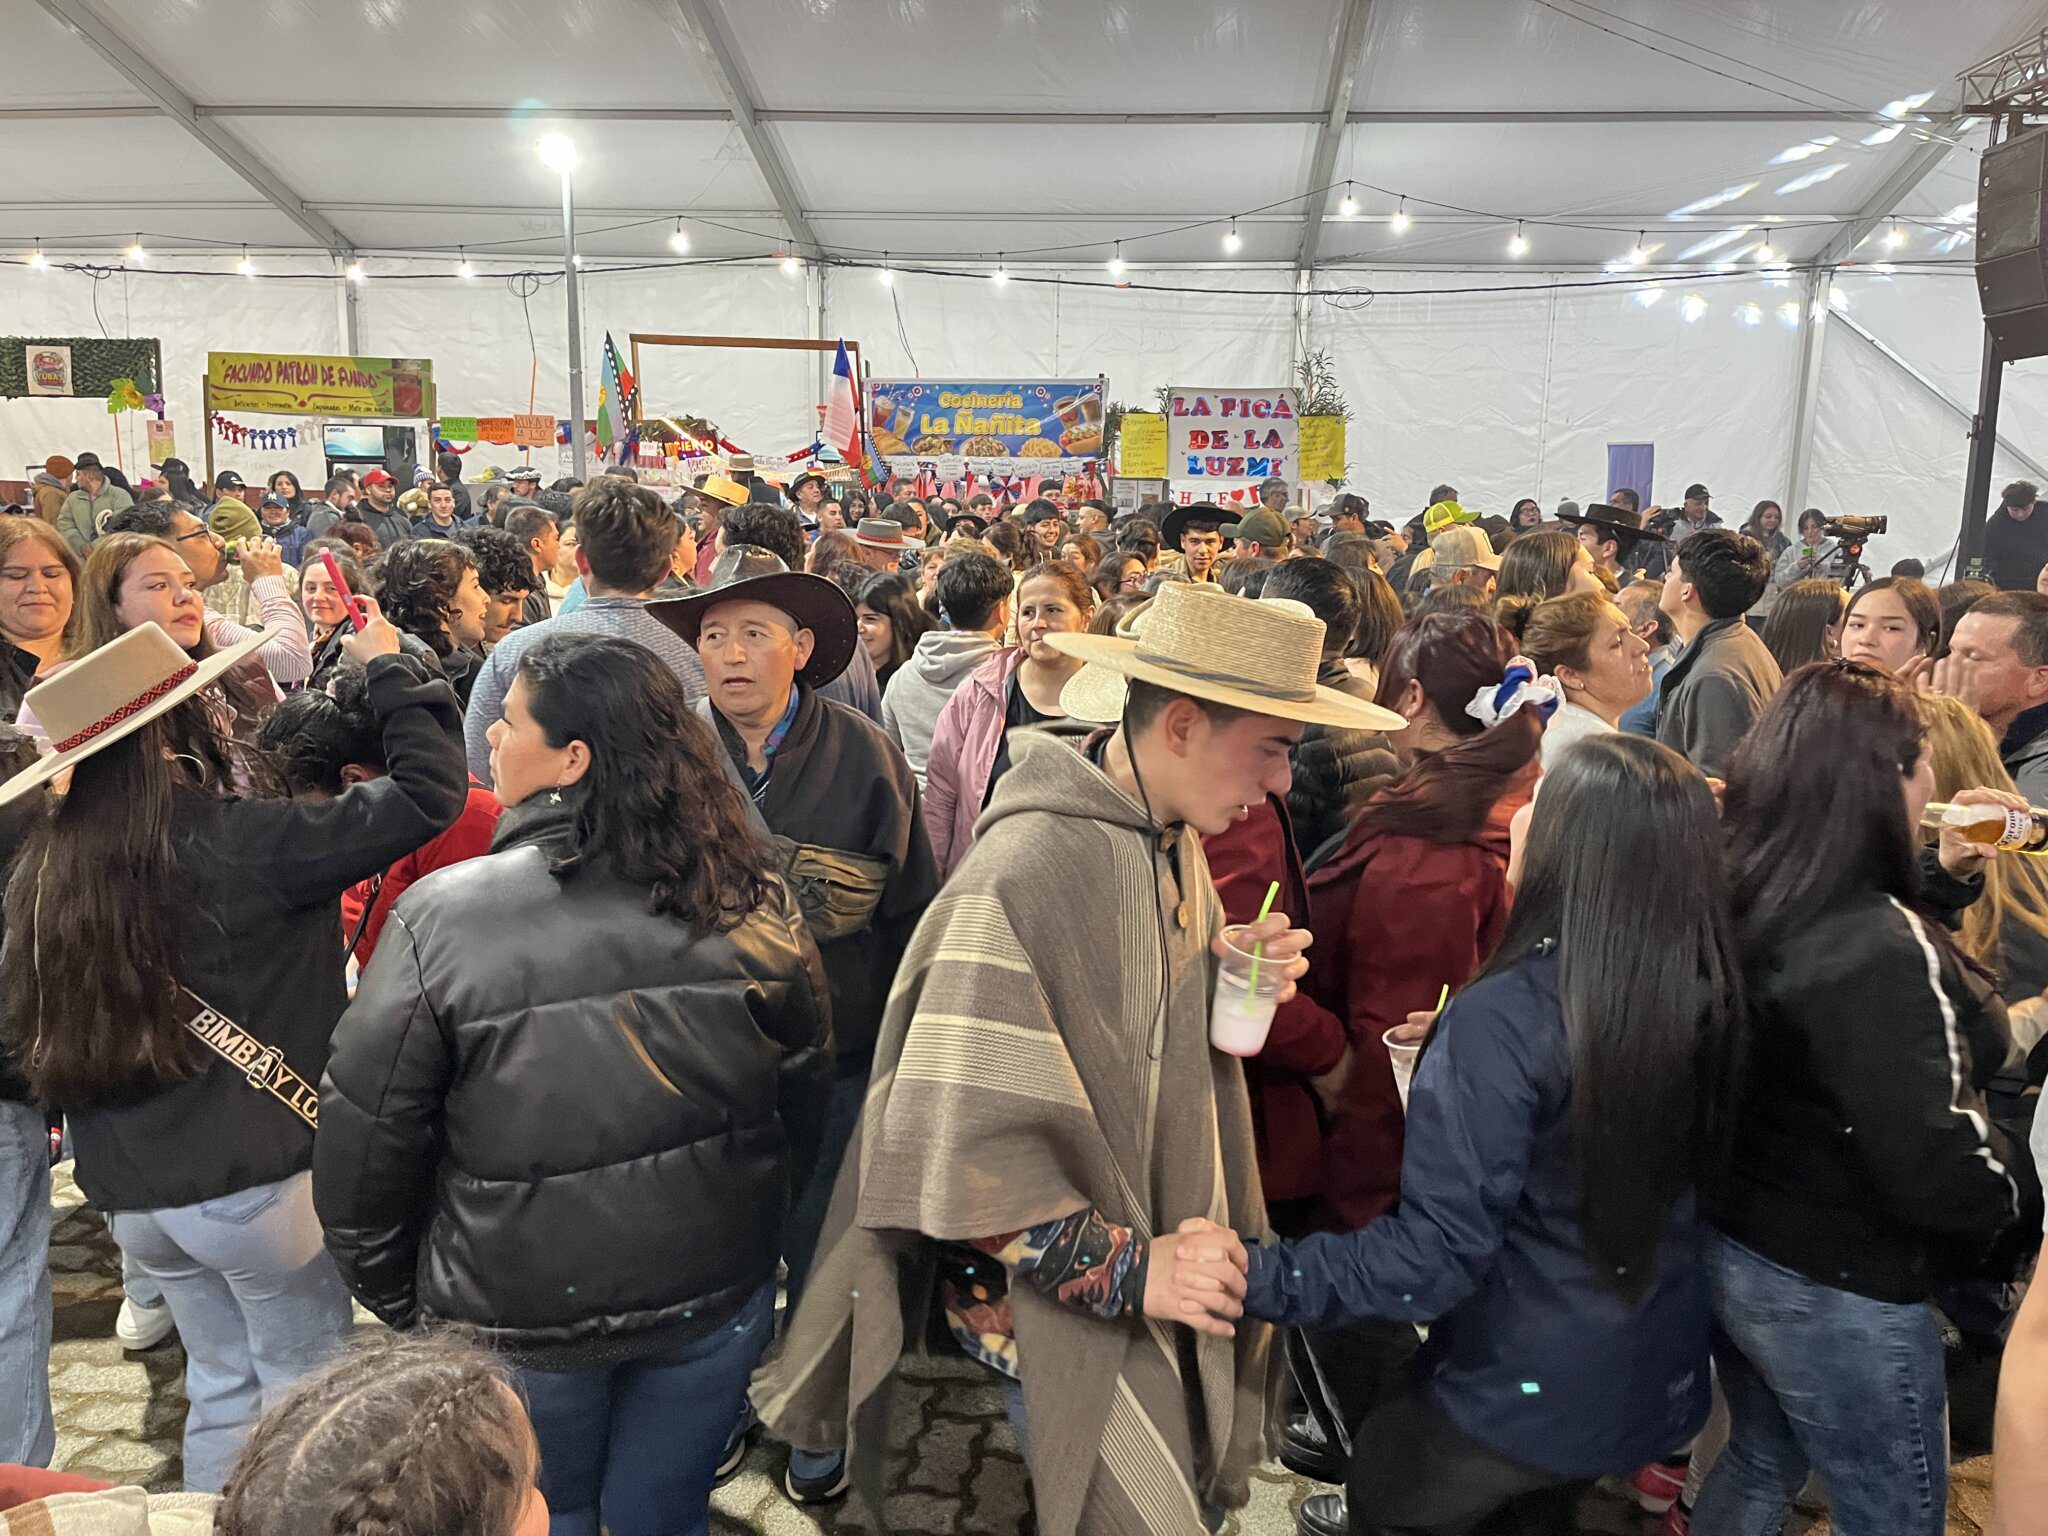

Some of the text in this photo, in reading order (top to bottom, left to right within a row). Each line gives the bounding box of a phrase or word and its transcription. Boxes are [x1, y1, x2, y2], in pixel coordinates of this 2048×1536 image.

[320, 364, 336, 387] DE
[1172, 396, 1212, 417] LA
[921, 410, 1041, 436] La Ñañita
[1188, 429, 1230, 450] DE
[1243, 428, 1285, 449] LA
[1187, 455, 1283, 477] LUZMI
[1996, 809, 2016, 847] Corona
